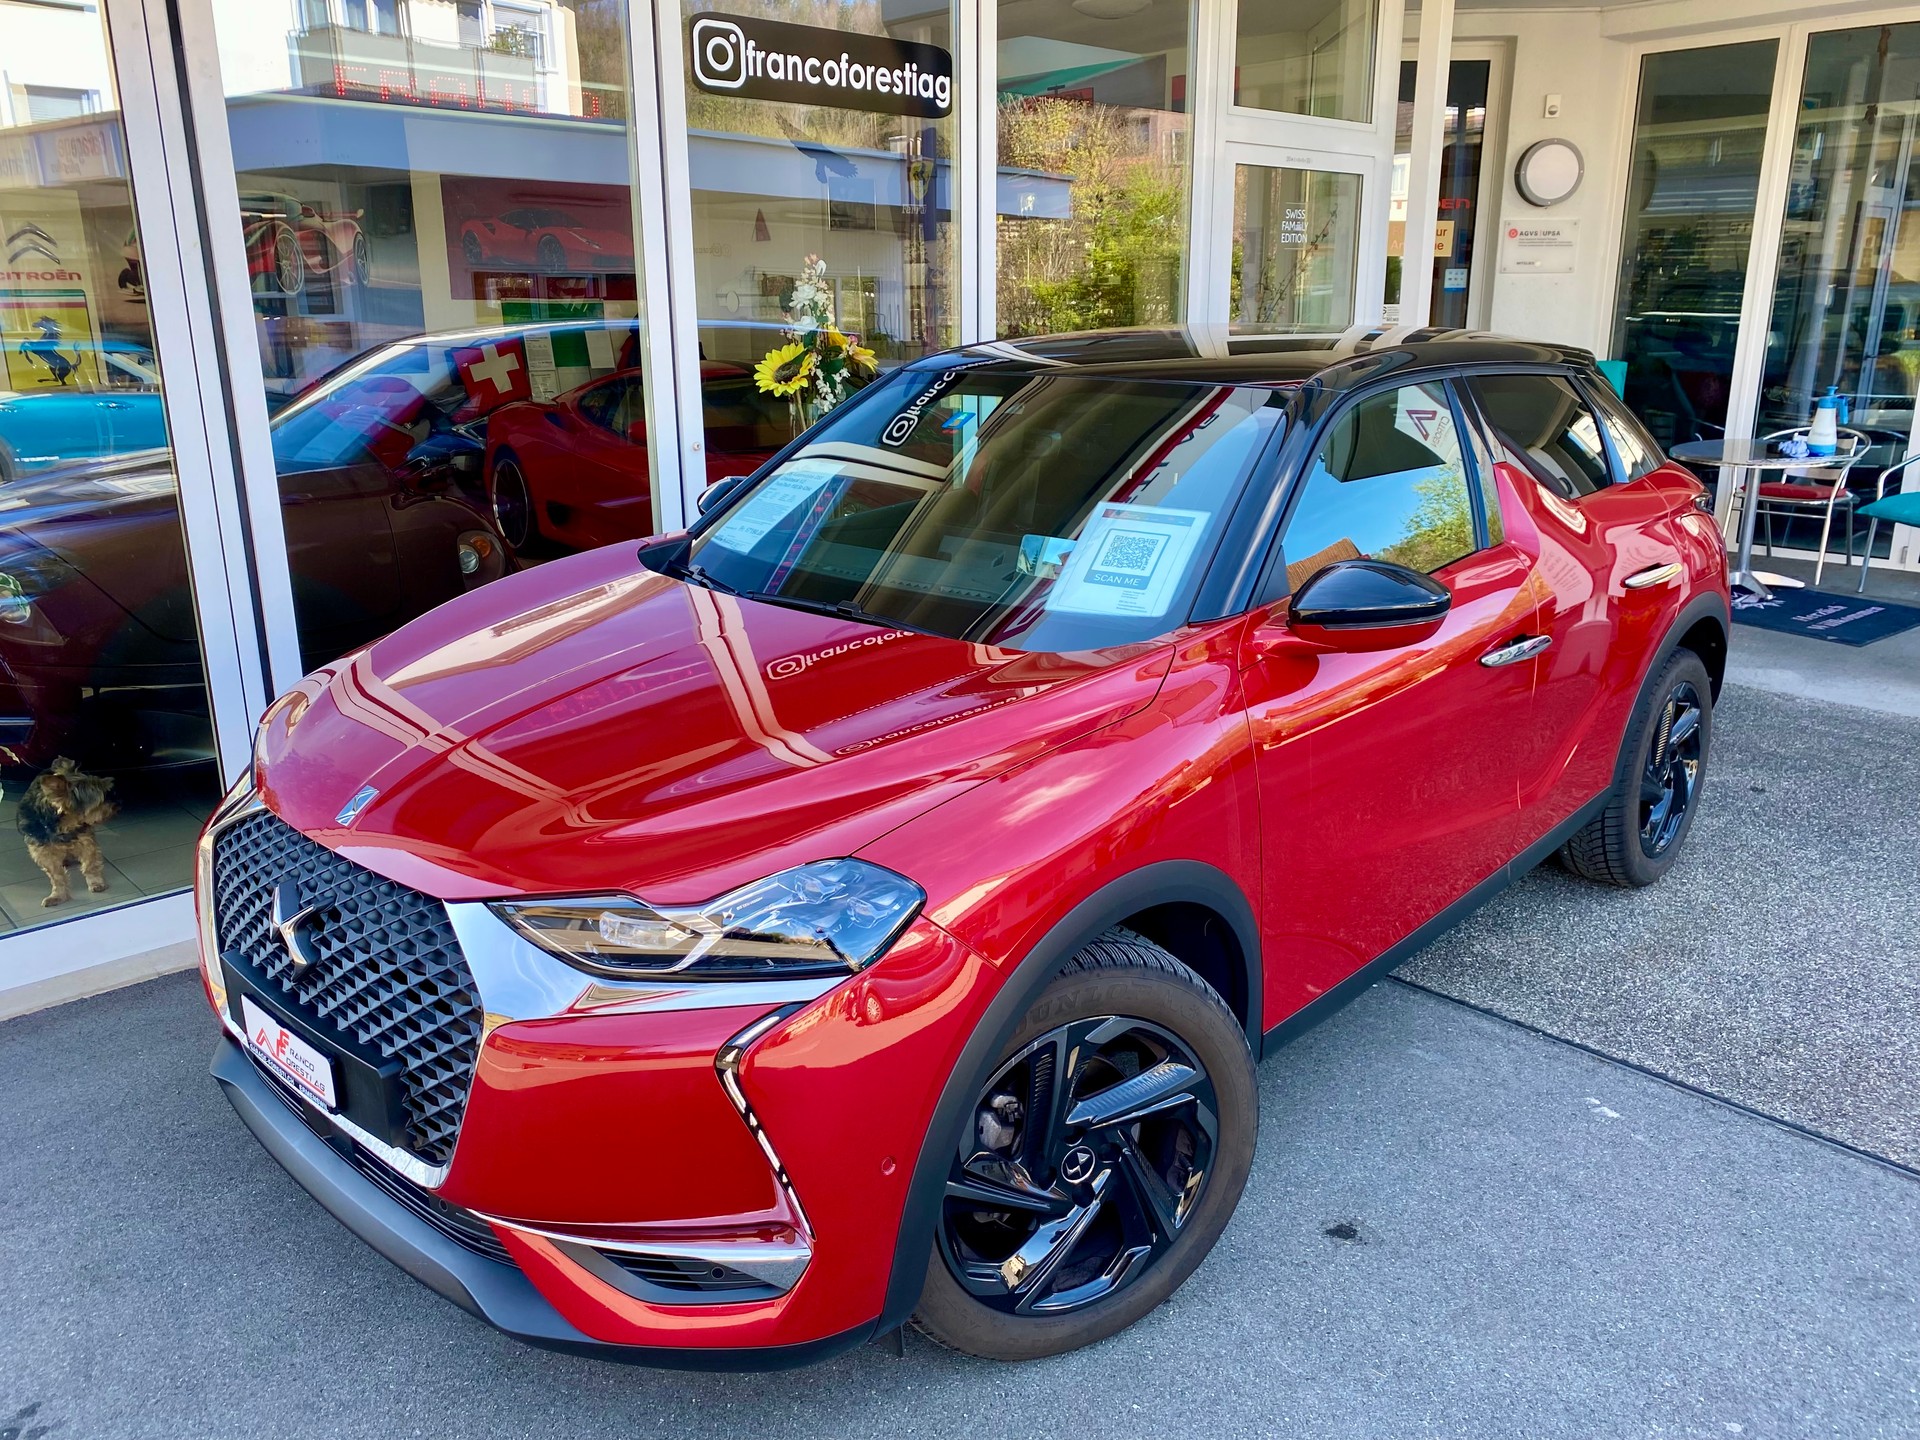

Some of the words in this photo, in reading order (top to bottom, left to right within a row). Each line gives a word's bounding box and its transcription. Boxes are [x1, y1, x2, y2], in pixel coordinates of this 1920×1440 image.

[746, 39, 951, 109] francoforestiag
[1285, 208, 1306, 220] SWISS
[1281, 232, 1307, 244] EDITION
[1093, 573, 1122, 585] SCAN
[1125, 577, 1142, 587] ME
